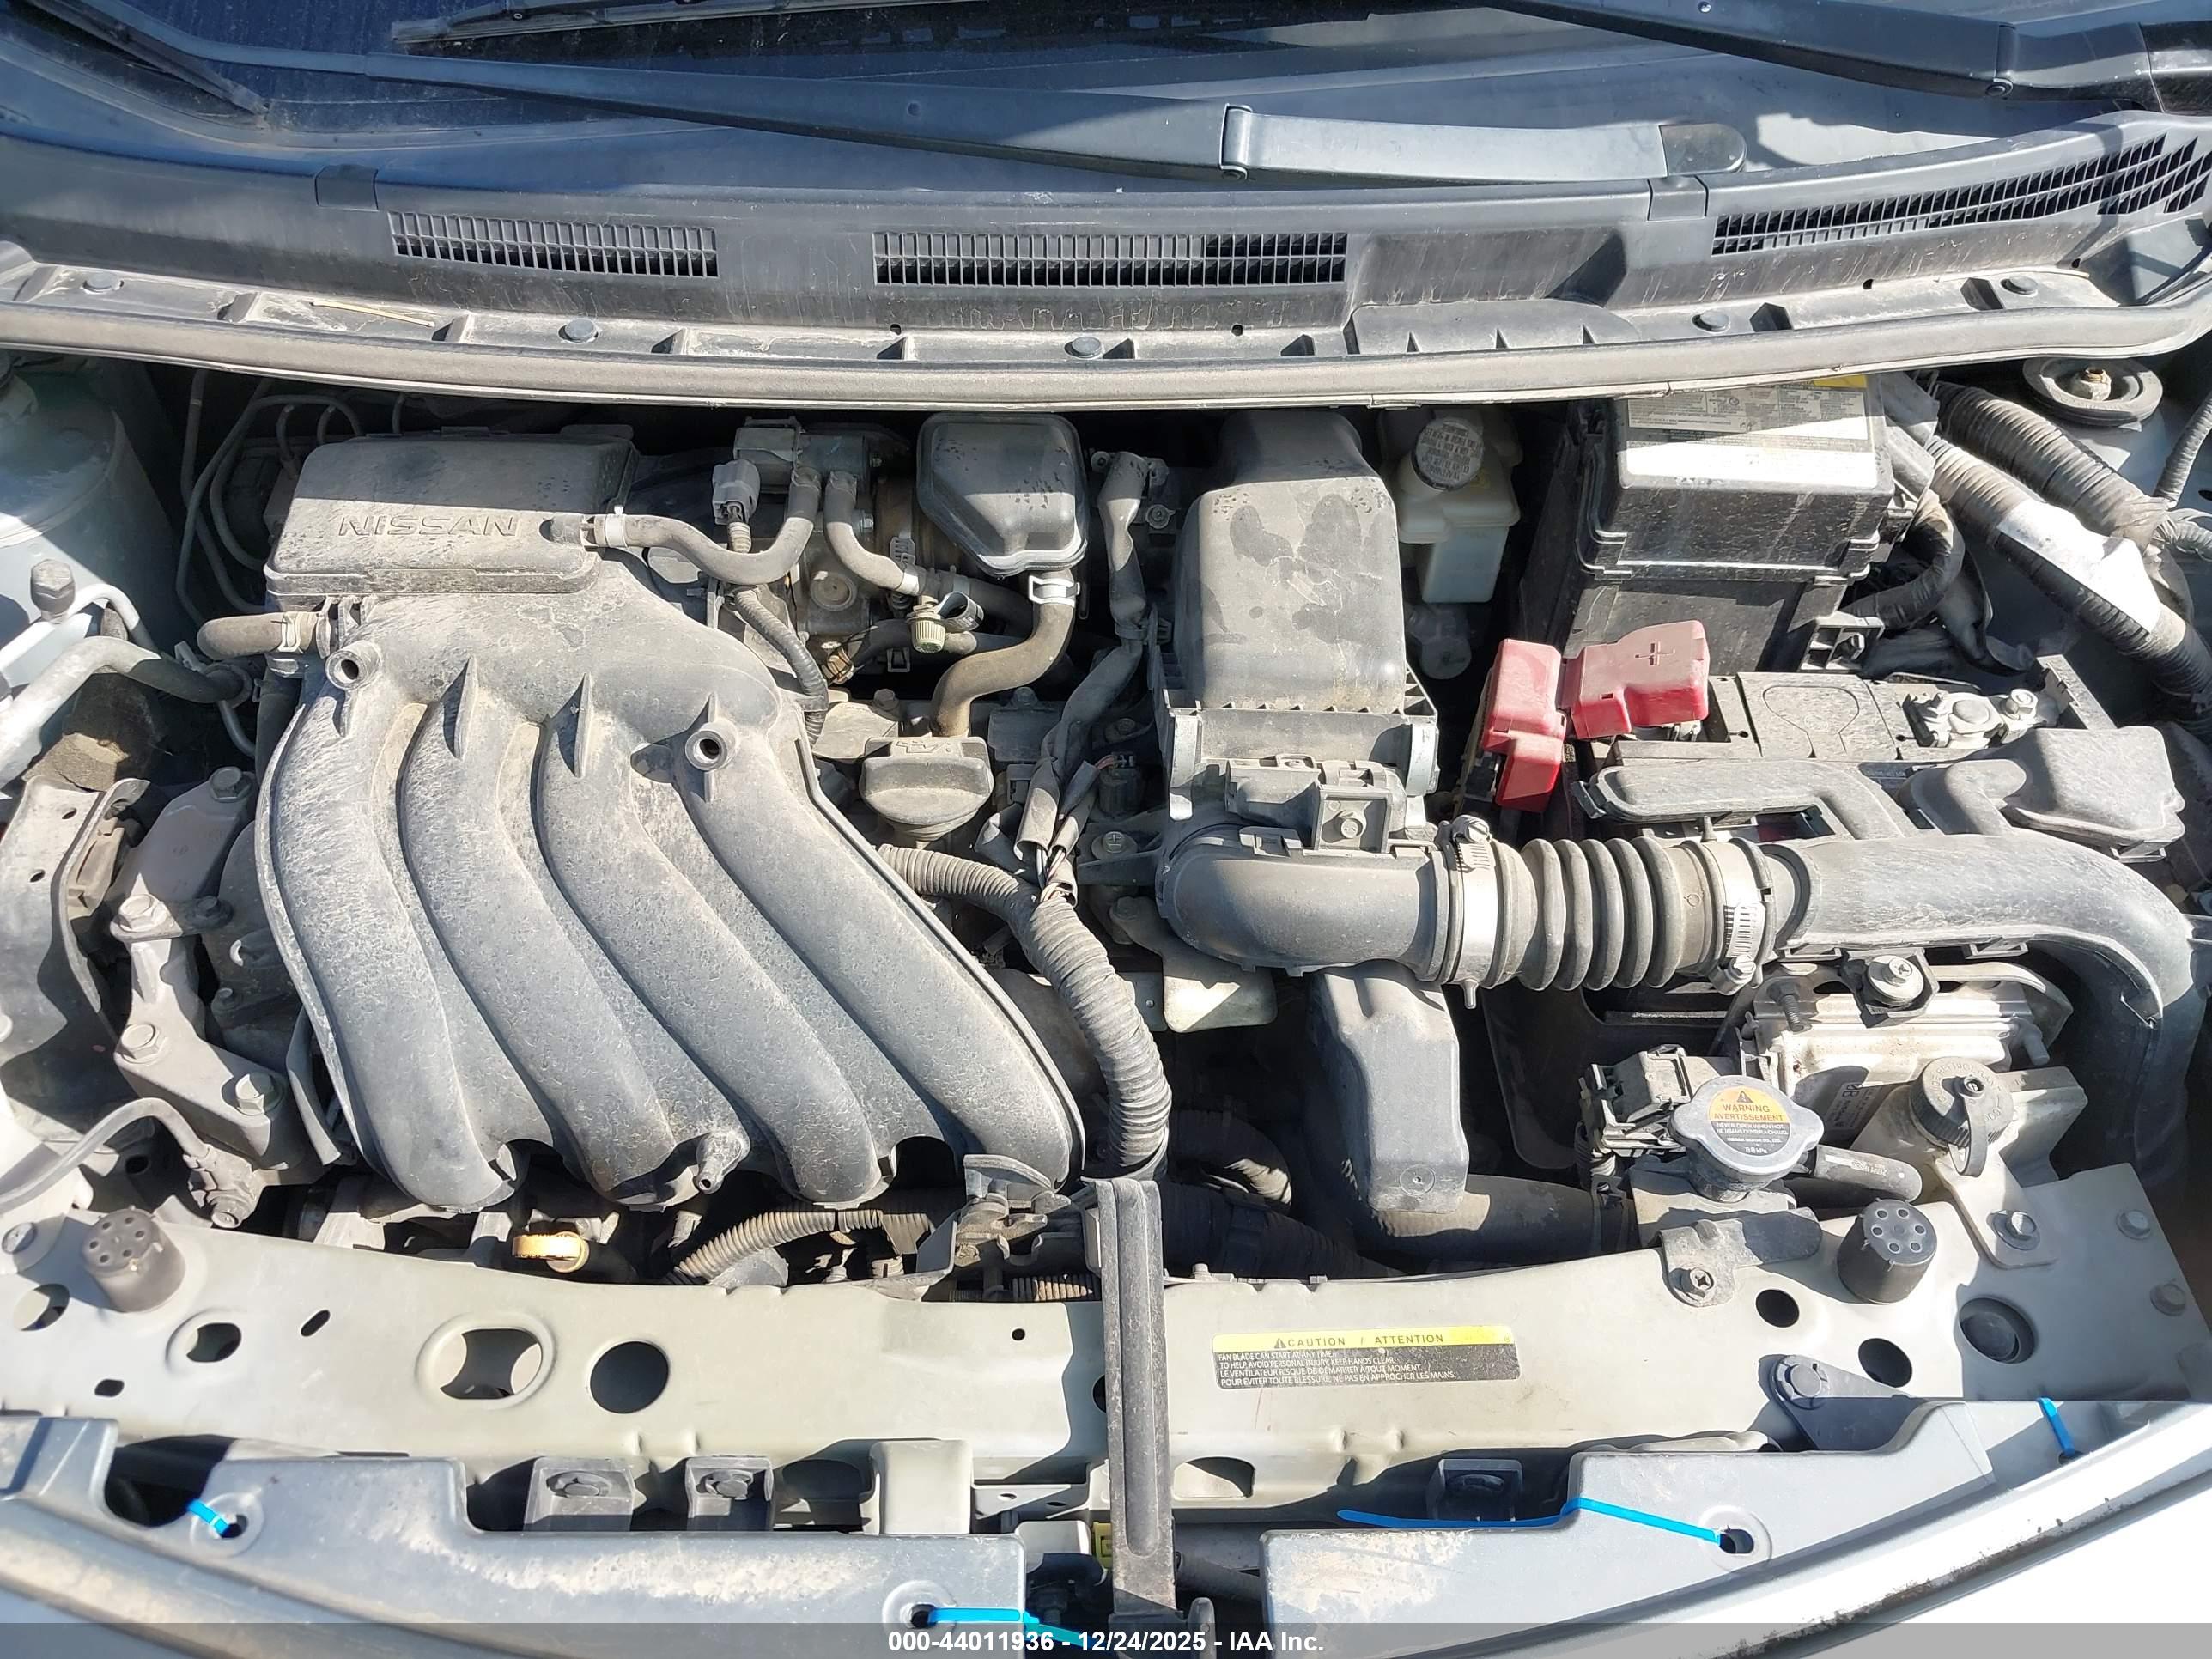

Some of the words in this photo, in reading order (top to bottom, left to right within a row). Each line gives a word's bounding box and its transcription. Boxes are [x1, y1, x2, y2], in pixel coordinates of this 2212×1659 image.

[338, 515, 518, 537] NISSAN
[1723, 1103, 1771, 1113] WARNING
[1714, 1113, 1784, 1121] AVERTISSEMENT
[1288, 1337, 1346, 1347] CAUTION
[1375, 1334, 1443, 1345] ATTENTION
[1232, 1352, 1254, 1361] BLADE
[1255, 1352, 1269, 1360] CAN
[1231, 1368, 1278, 1377] VENTILATEUR
[1279, 1367, 1305, 1376] RISQUE
[1366, 1364, 1385, 1372] TOUT
[1388, 1364, 1423, 1372] MOMENT.
[1269, 1376, 1292, 1384] TOUTE
[1345, 1373, 1358, 1382] PAS
[1359, 1372, 1370, 1381] EN
[1371, 1371, 1415, 1381] APPROCHER
[1430, 1370, 1455, 1379] MAINS.
